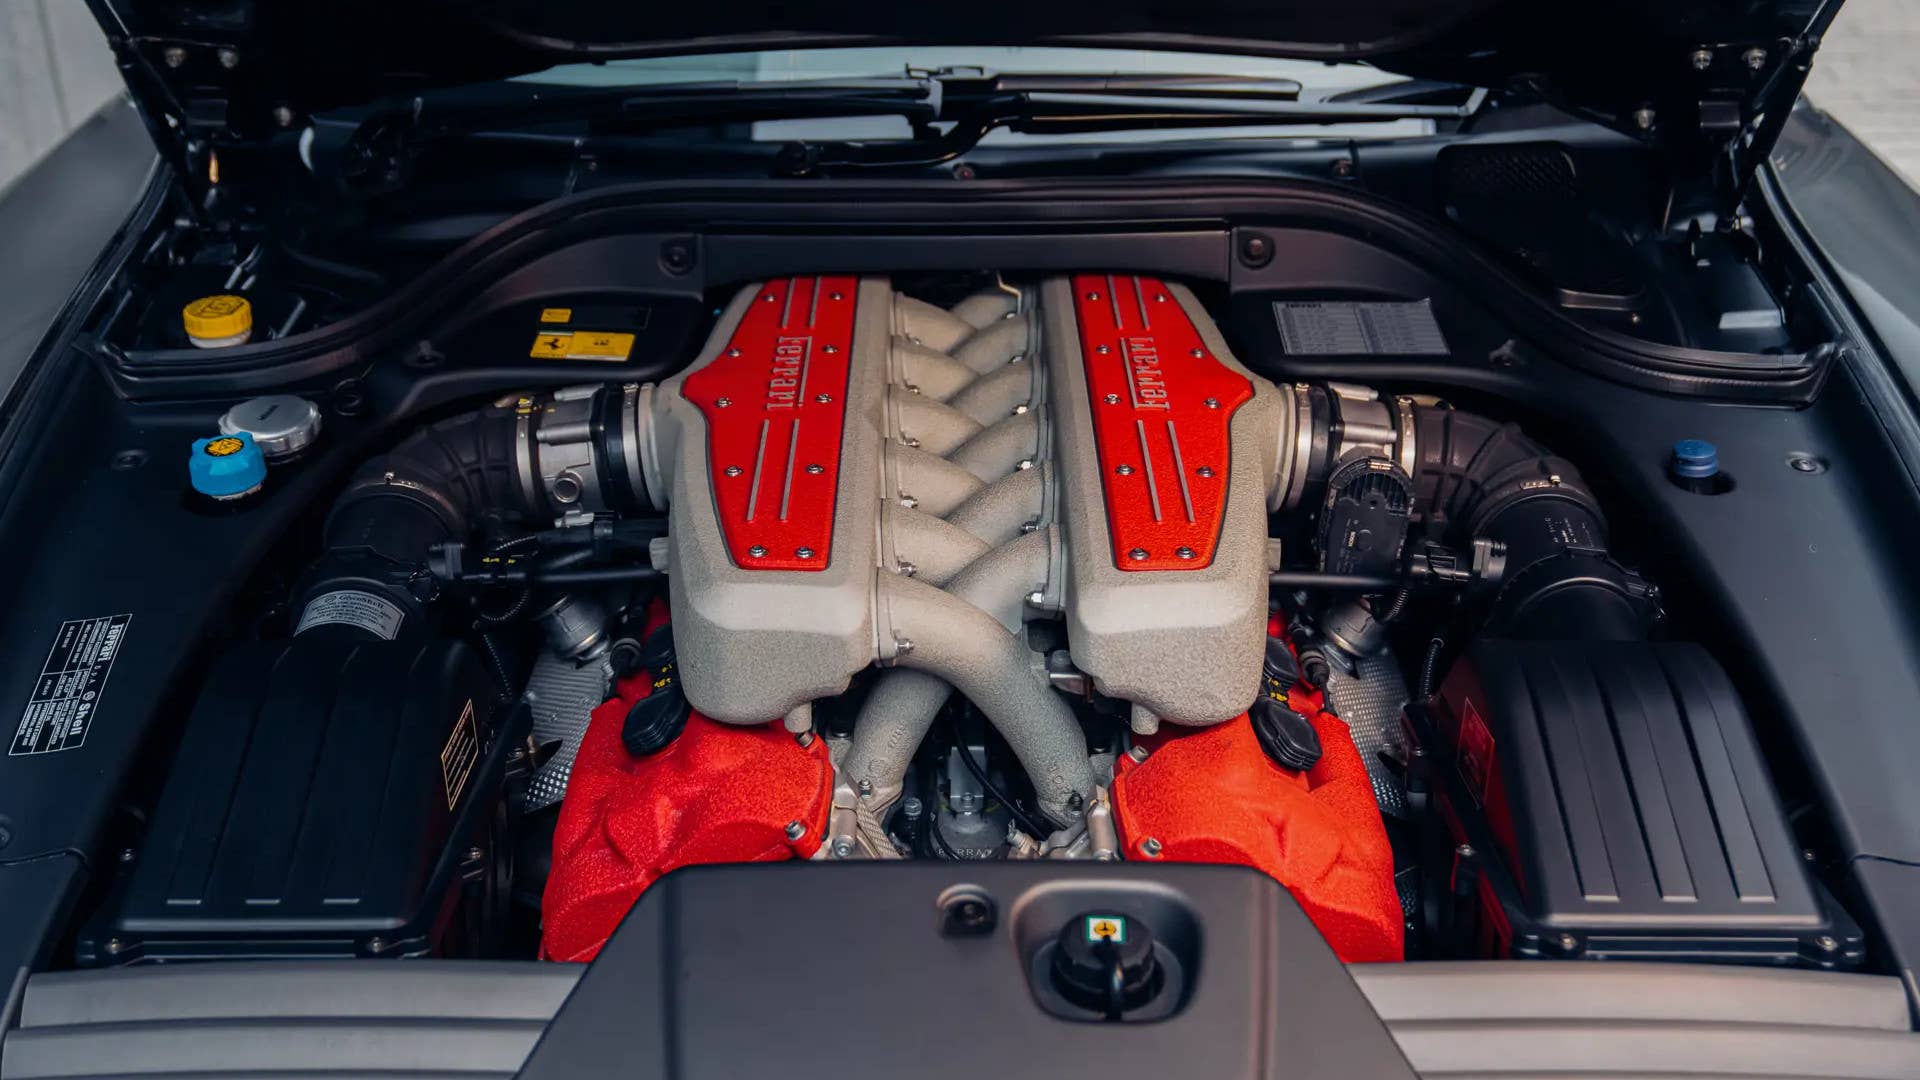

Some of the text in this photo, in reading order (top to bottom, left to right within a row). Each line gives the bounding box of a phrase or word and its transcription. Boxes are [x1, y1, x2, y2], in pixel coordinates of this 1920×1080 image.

[766, 336, 812, 410] Ferrari
[1120, 337, 1169, 409] Ferrari
[97, 623, 124, 662] Ferrari
[69, 703, 91, 735] Shell
